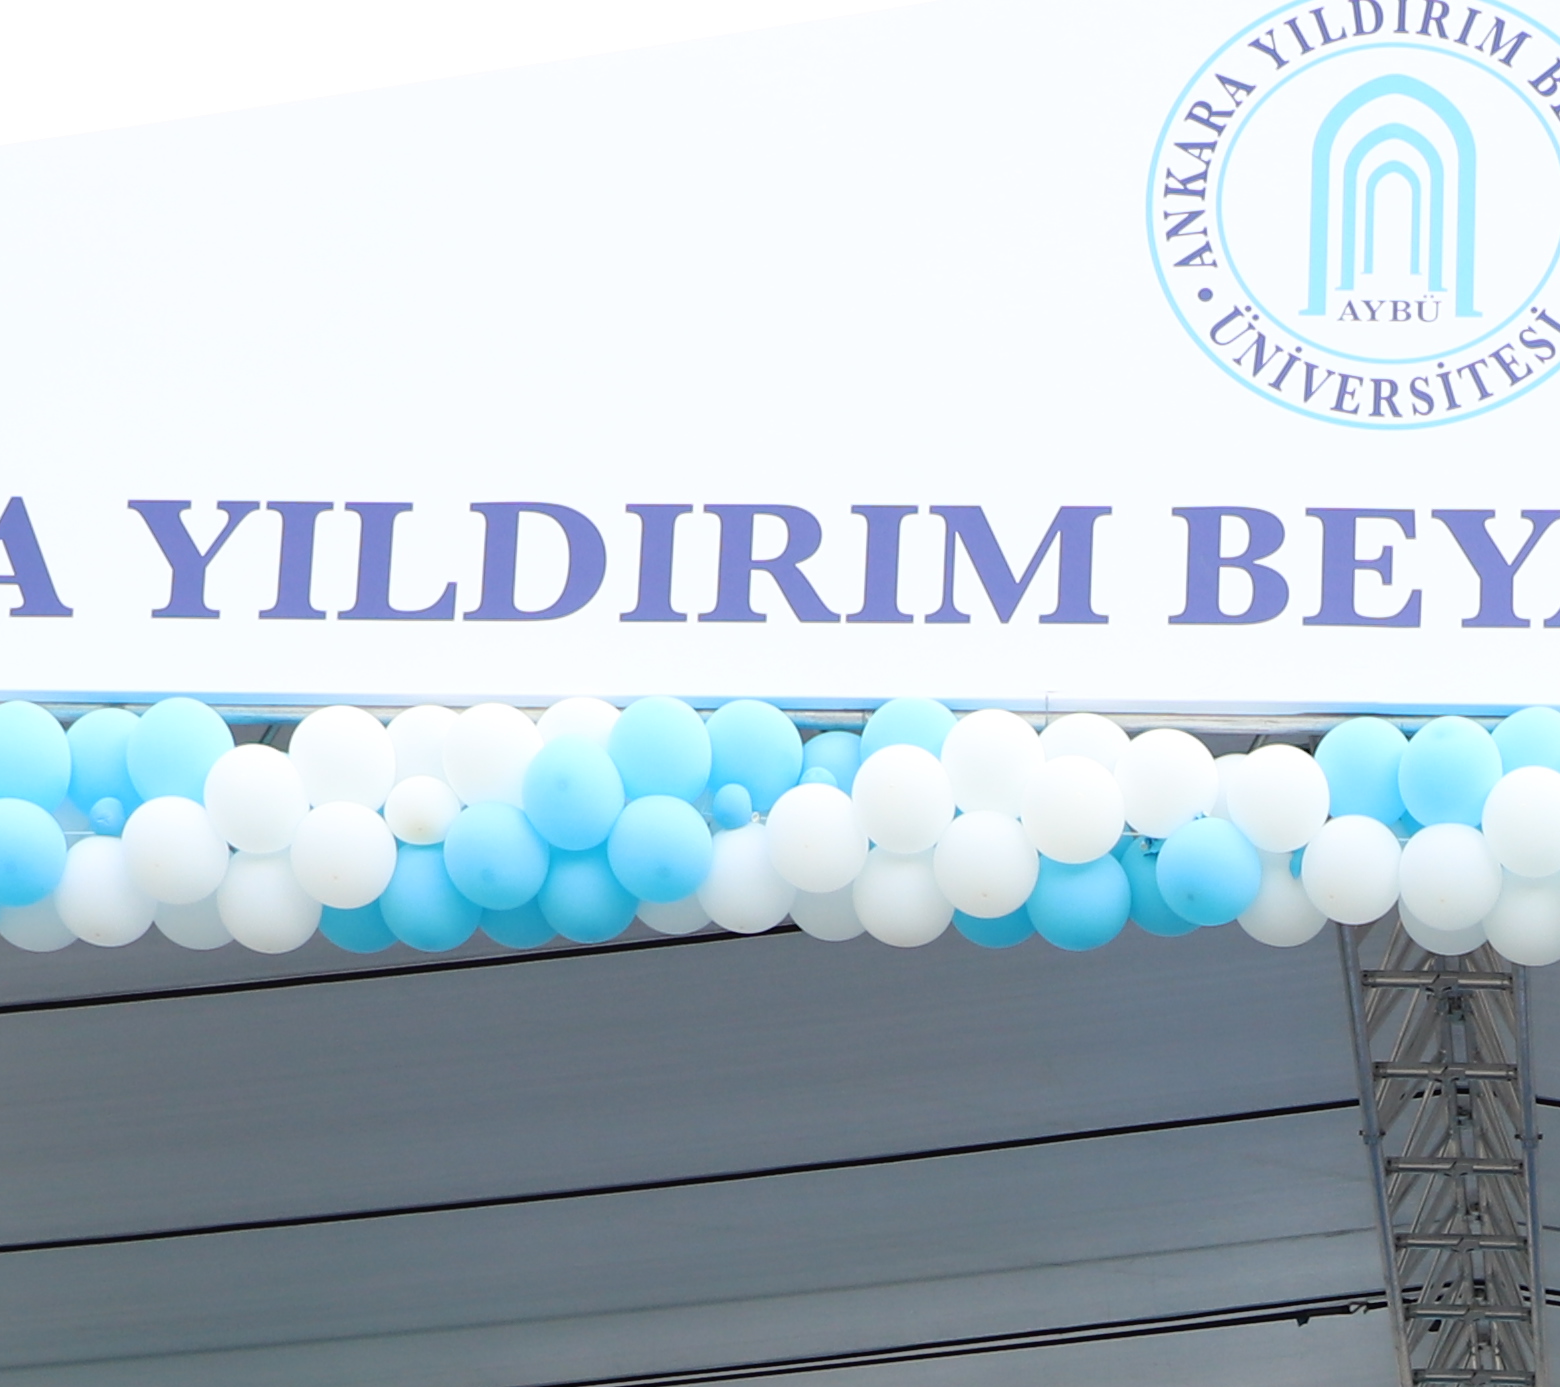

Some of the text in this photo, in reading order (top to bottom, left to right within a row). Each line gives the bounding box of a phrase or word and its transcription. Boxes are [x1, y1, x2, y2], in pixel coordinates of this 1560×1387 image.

[1163, 72, 1257, 269] ANKARA
[1248, 0, 1532, 70] YILDIRIM
[1338, 295, 1442, 322] AYBÜ
[127, 499, 1112, 625] YILDIRIM
